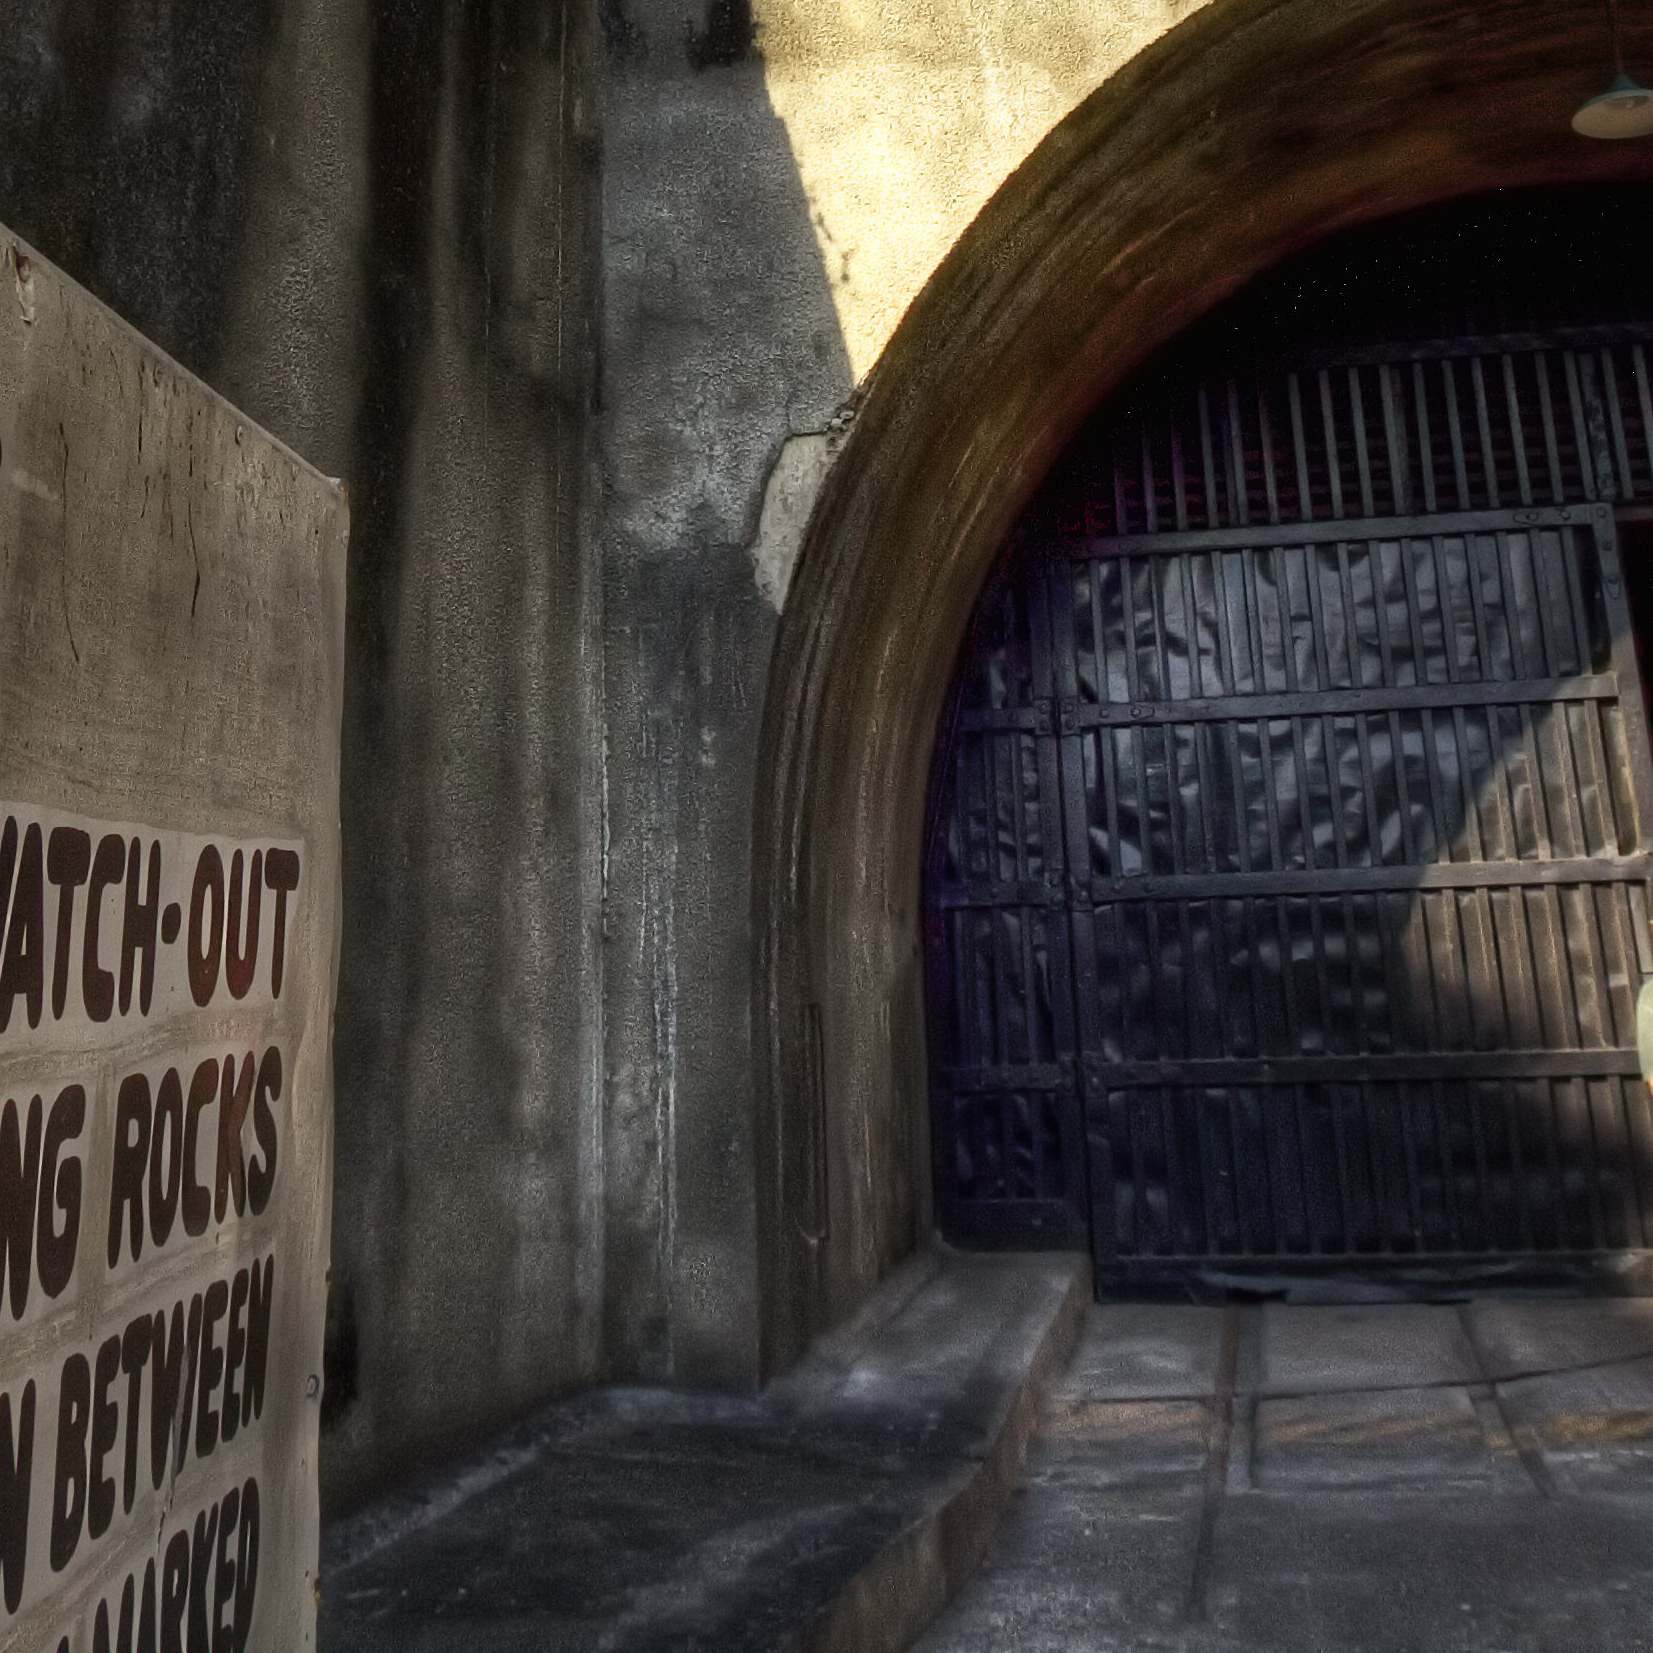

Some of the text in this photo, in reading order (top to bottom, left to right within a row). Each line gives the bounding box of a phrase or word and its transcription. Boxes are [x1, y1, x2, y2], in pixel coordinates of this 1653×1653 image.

[107, 1045, 283, 1270] ROCKS
[50, 1253, 274, 1573] BETWEEN
[92, 1476, 260, 1653] RKED
